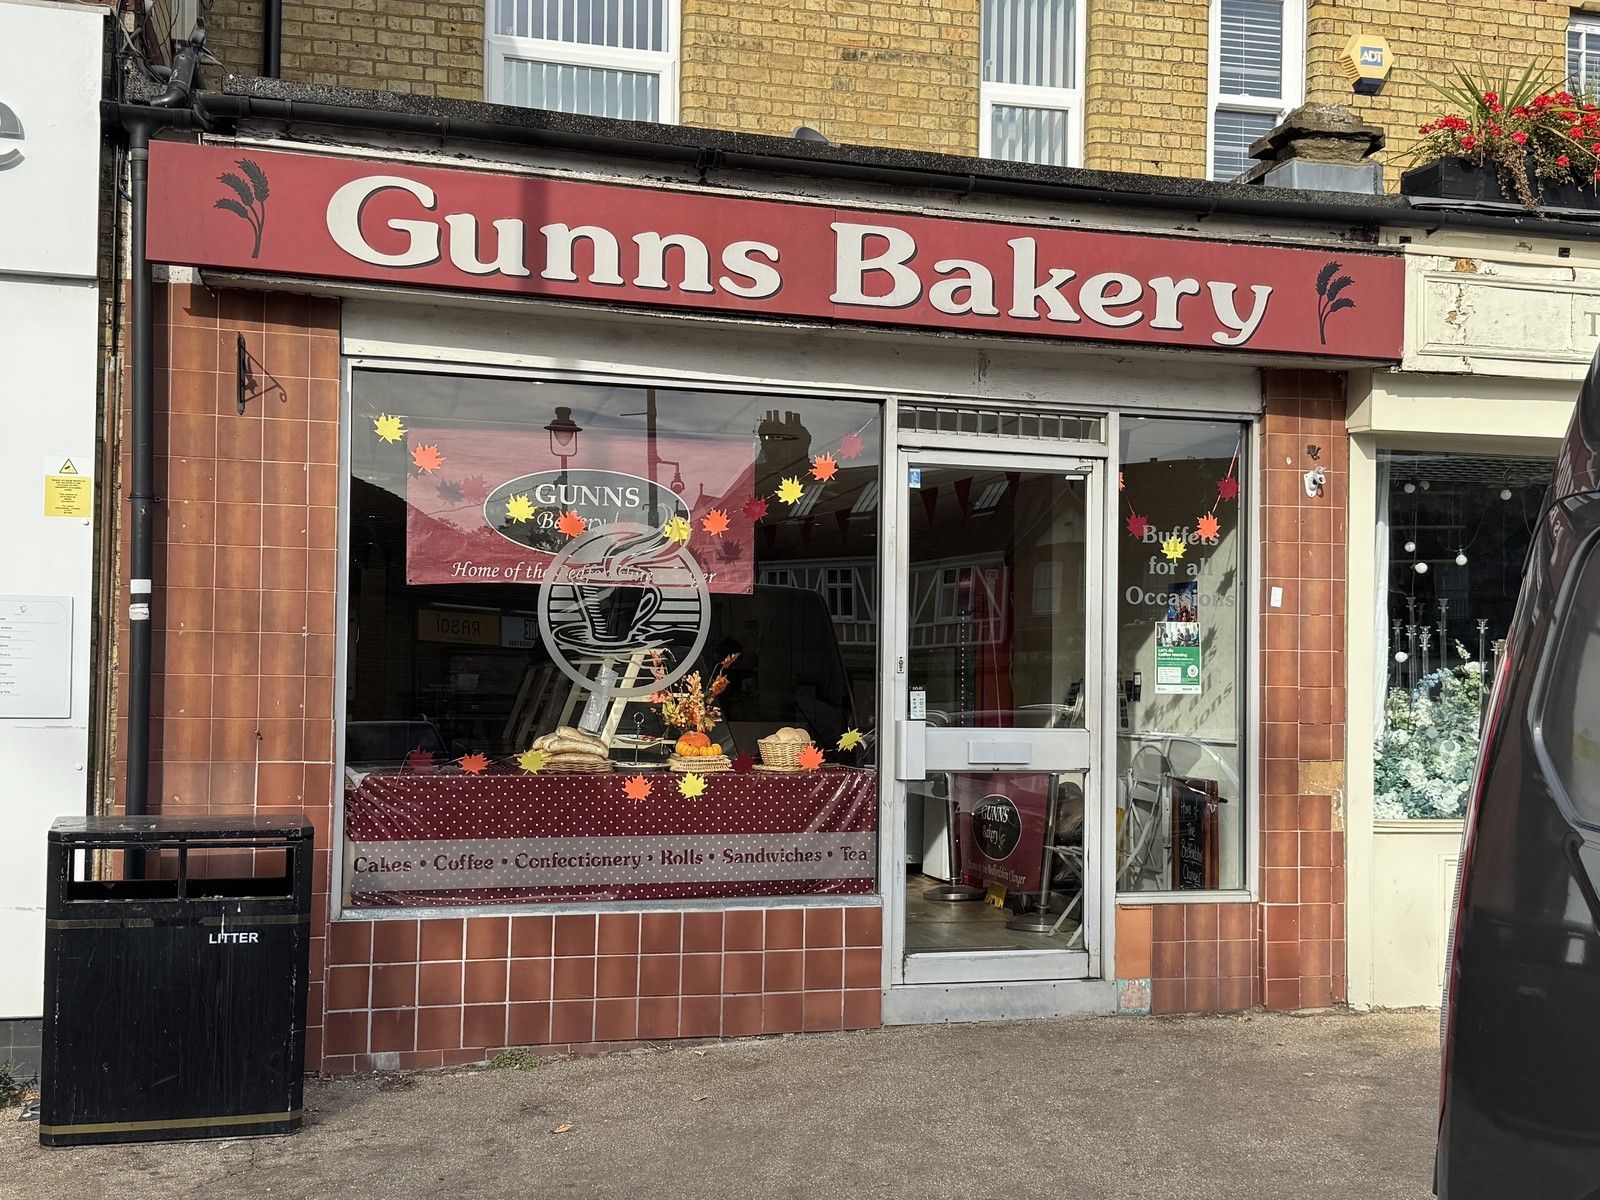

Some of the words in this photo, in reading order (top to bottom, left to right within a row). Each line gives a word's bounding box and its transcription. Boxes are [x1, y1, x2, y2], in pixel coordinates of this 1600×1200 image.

[1361, 49, 1384, 63] ADT
[325, 175, 783, 300] Gunns
[829, 221, 1273, 347] Bakery
[535, 484, 640, 507] GUNNS
[1142, 525, 1220, 546] Buffes
[451, 561, 500, 578] Home
[504, 561, 525, 583] of
[1148, 556, 1178, 575] for
[1186, 558, 1213, 576] all
[1125, 585, 1235, 608] Occasions
[981, 804, 1010, 823] GUNNS
[353, 857, 412, 873] Cakes
[433, 853, 494, 871] Coffee
[514, 852, 642, 870] Confectionery
[660, 849, 703, 866] Rolls
[722, 847, 822, 865] Sandwiches
[840, 846, 868, 861] Tea
[209, 932, 259, 944] LITTER
